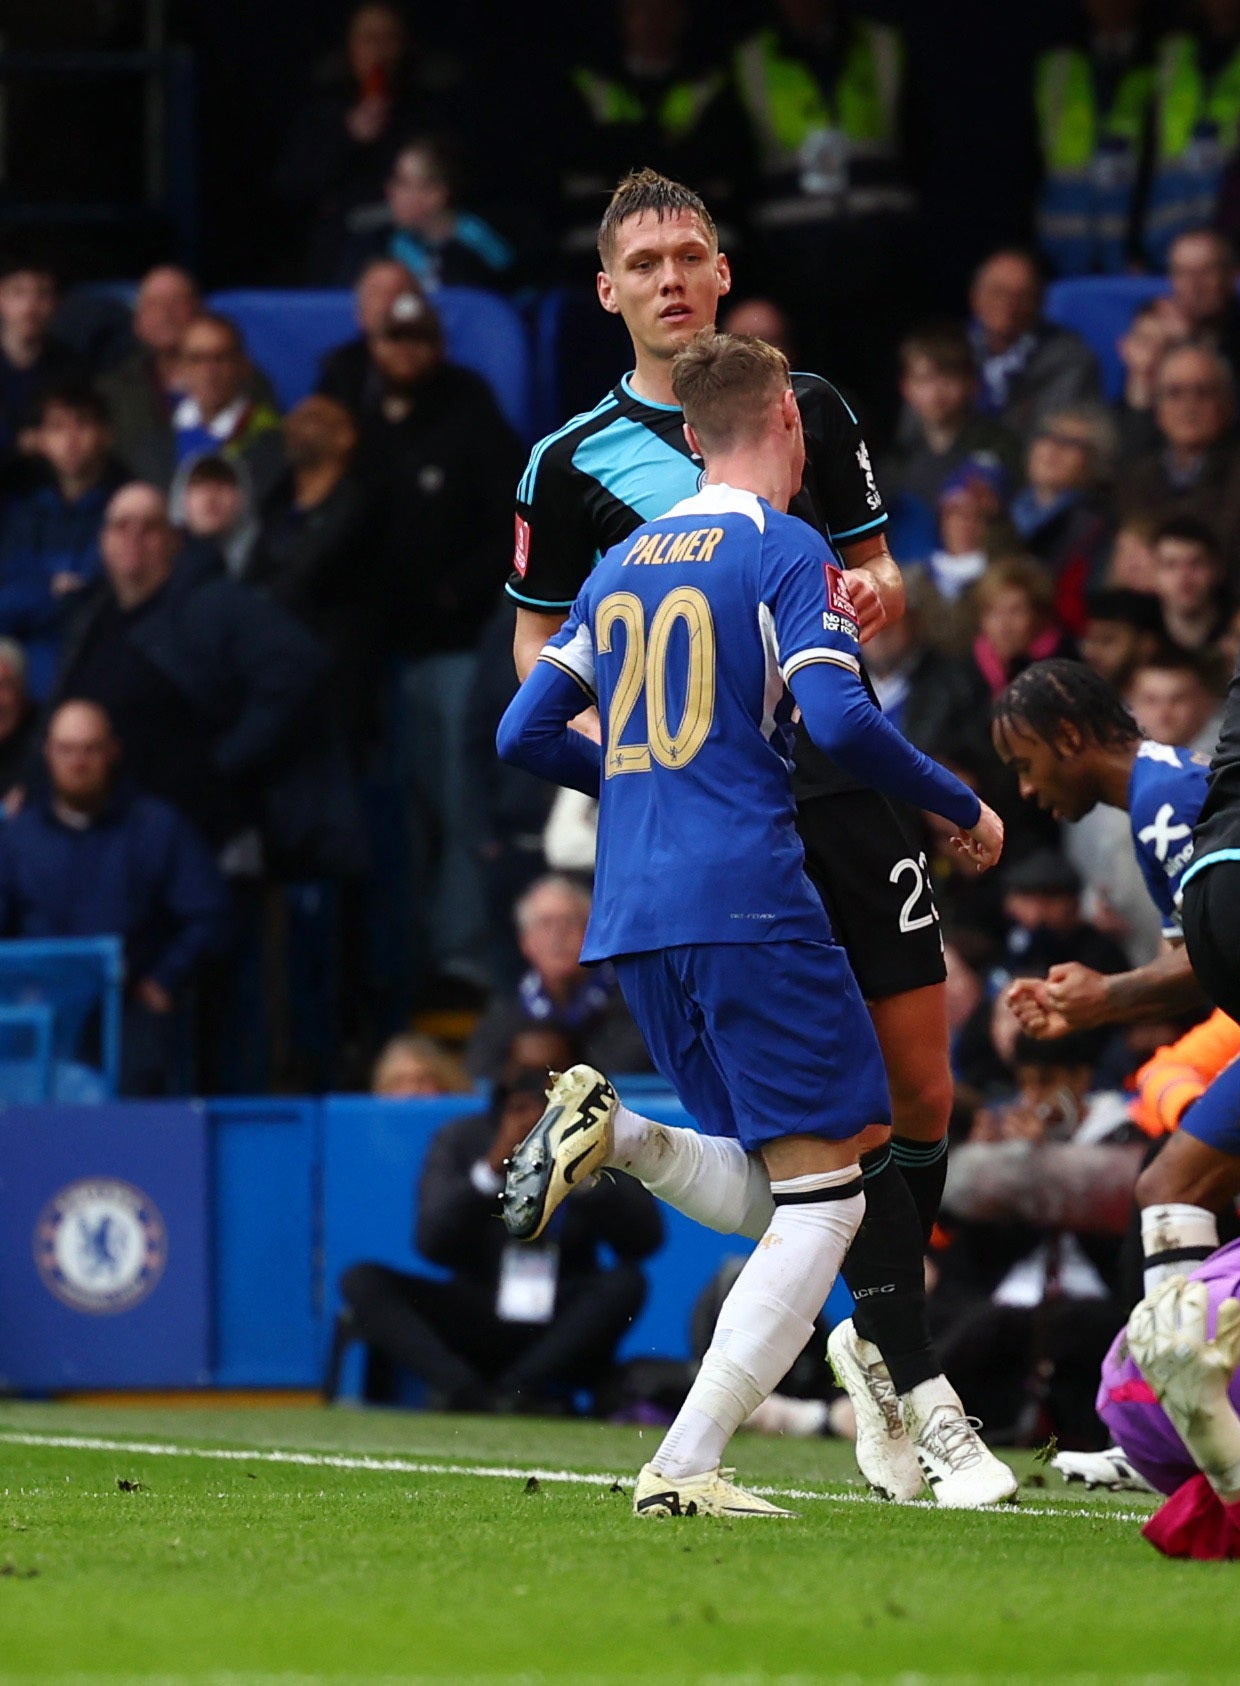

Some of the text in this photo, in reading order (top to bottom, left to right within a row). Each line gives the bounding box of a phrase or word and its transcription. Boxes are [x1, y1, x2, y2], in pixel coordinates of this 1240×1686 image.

[621, 526, 726, 568] PALMER
[595, 585, 717, 780] 20
[852, 1284, 896, 1300] LCFC
